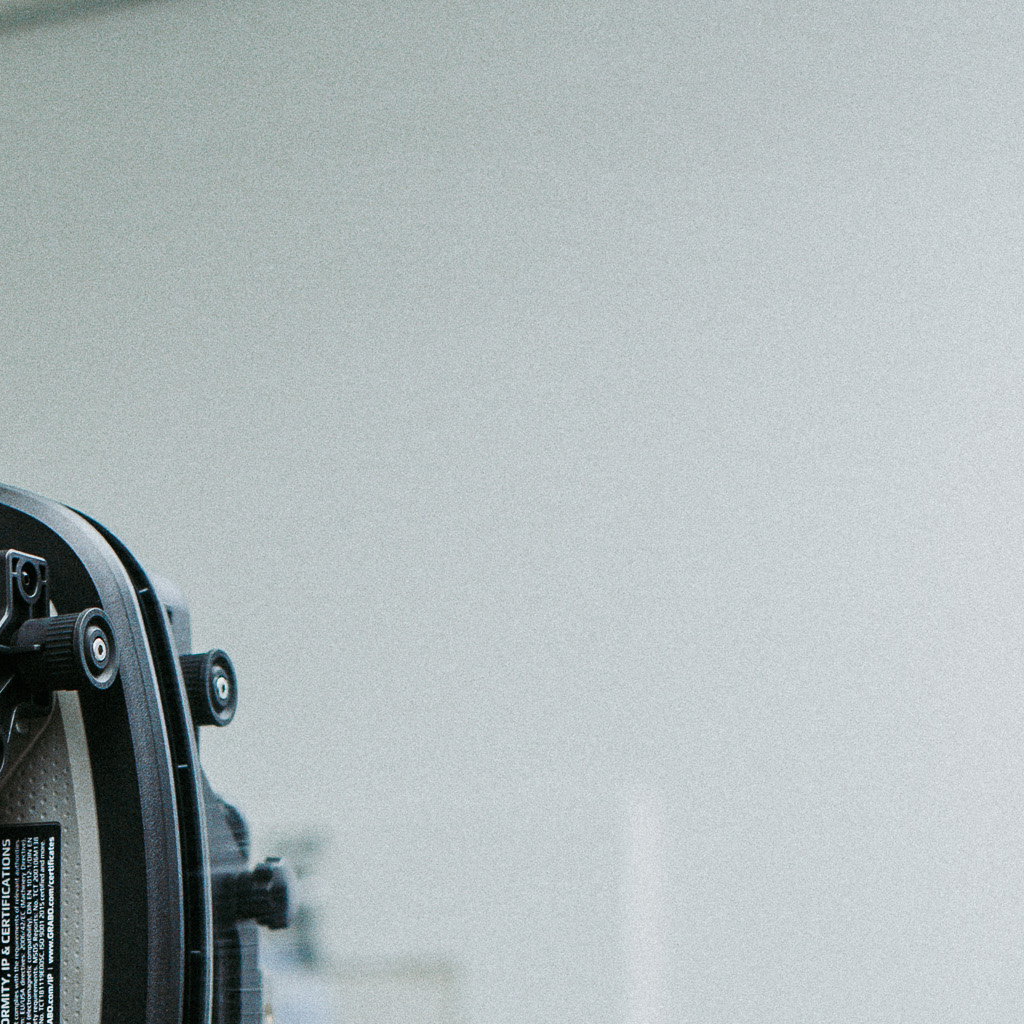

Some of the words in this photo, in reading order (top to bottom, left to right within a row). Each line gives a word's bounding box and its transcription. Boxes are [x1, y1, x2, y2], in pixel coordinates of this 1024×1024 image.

[1, 838, 11, 944] CERTIFICATIONS
[14, 906, 20, 914] of
[1, 946, 11, 956] &
[1, 958, 11, 971] IP
